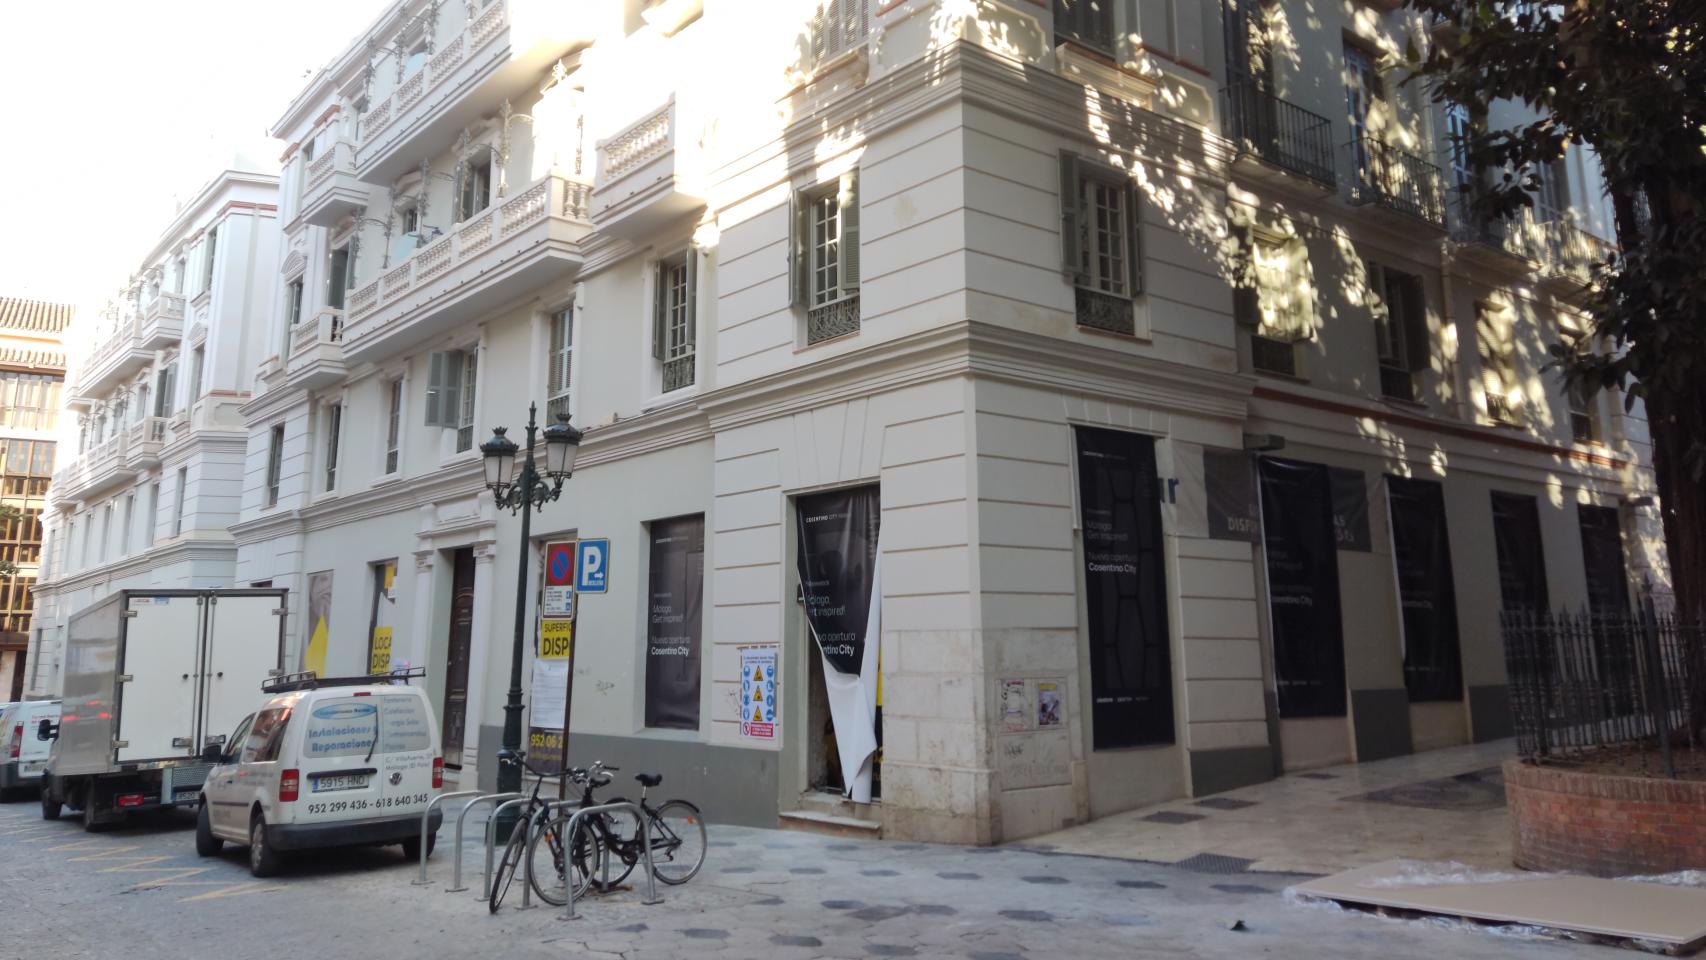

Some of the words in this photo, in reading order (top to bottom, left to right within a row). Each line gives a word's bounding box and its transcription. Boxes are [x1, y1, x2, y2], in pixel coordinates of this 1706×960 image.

[581, 546, 602, 586] P
[1088, 562, 1124, 572] Cosentino
[1124, 564, 1137, 575] City
[827, 632, 856, 643] apertura
[543, 637, 569, 656] DISP
[651, 646, 677, 656] Cosentino
[677, 646, 690, 657] City
[839, 644, 855, 657] City
[312, 738, 375, 752] Reparacione
[319, 777, 344, 788] 5915
[308, 804, 326, 814] 952
[329, 802, 347, 812] 299
[350, 800, 367, 810] 436
[376, 798, 392, 808] 618
[395, 796, 411, 806] 640
[413, 793, 428, 803] 345
